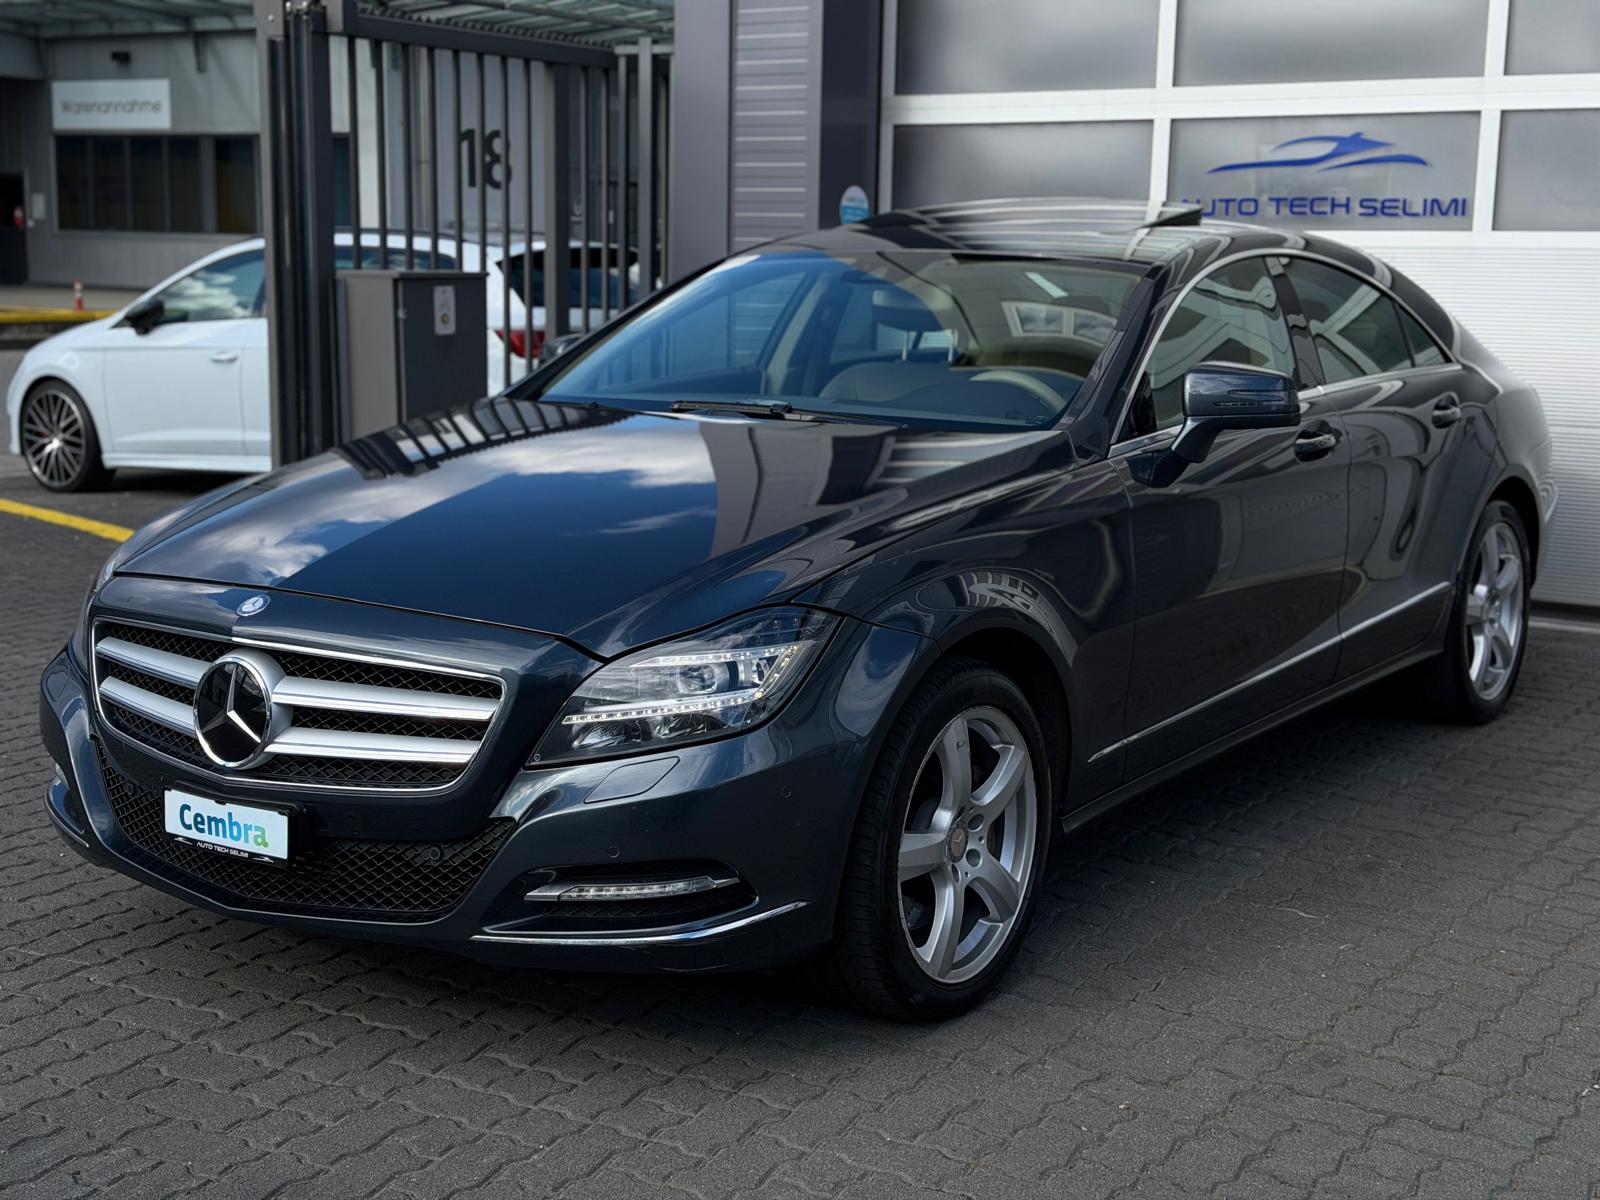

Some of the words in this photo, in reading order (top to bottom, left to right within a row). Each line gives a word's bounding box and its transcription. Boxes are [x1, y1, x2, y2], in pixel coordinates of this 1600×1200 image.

[62, 98, 162, 114] Warenannahme
[458, 128, 512, 189] 18
[1182, 197, 1259, 217] UTO
[1269, 196, 1351, 216] TECH
[1358, 197, 1467, 217] SELIMI
[179, 803, 269, 848] Cembra
[196, 841, 213, 850] AUTO
[213, 845, 229, 854] TECH
[229, 849, 249, 859] SELIMI
